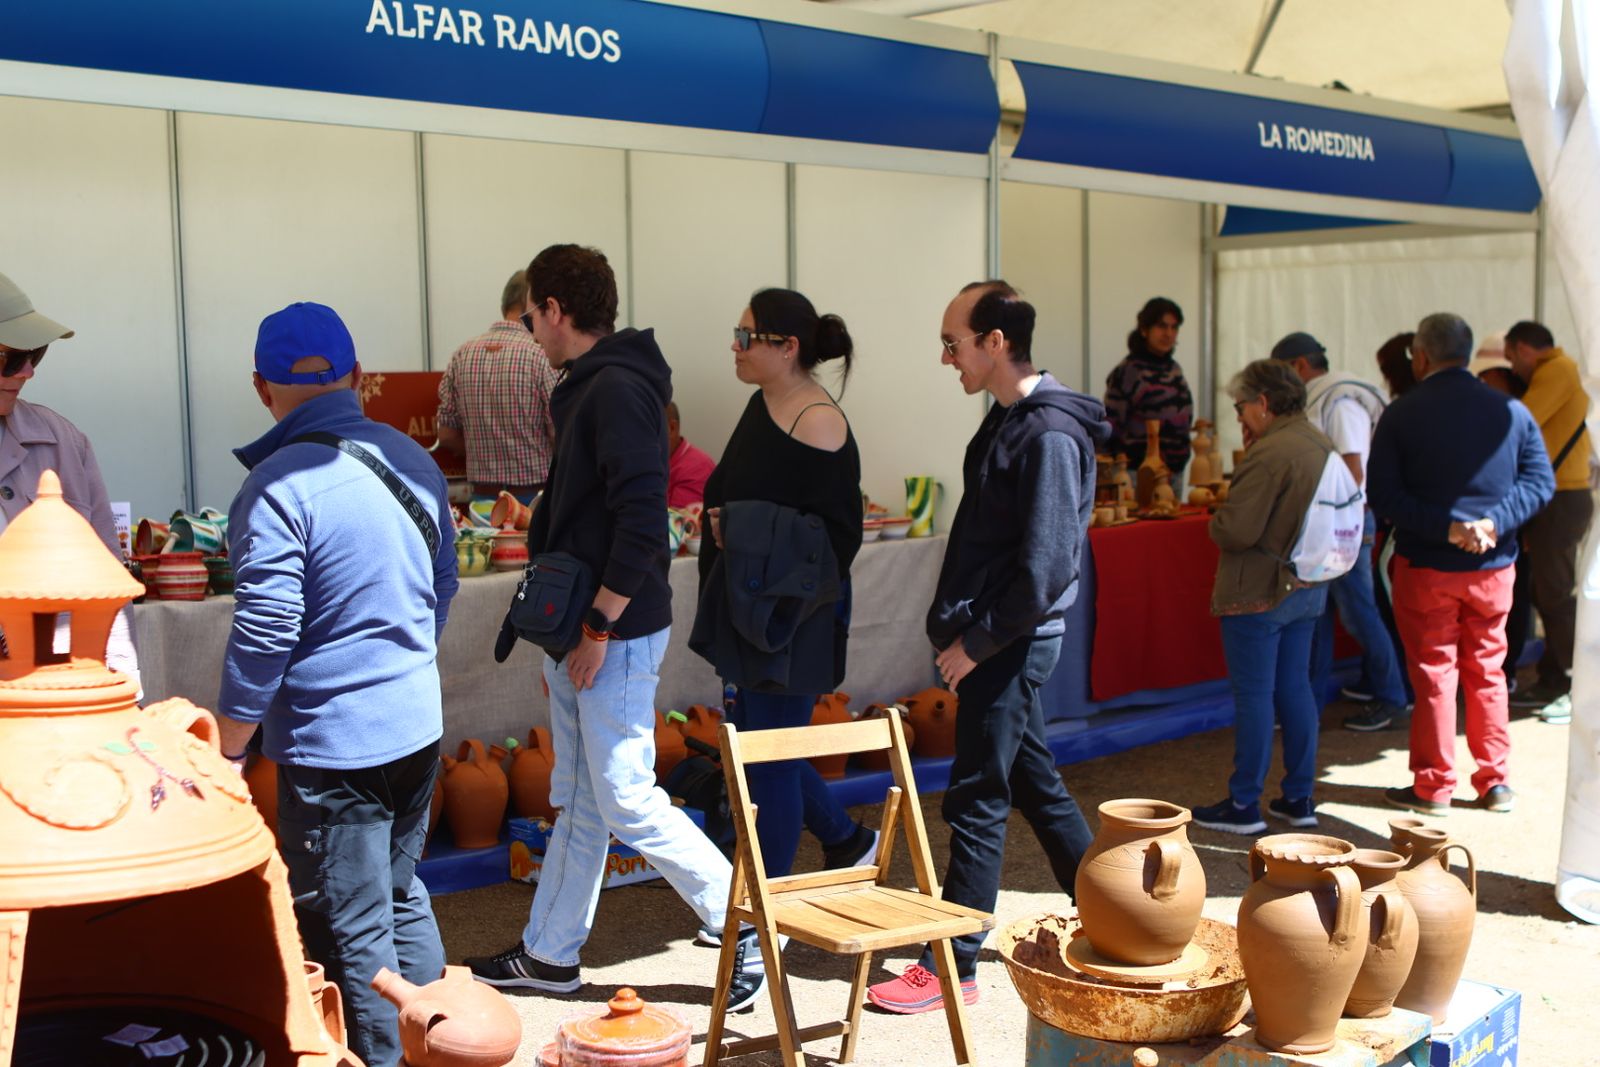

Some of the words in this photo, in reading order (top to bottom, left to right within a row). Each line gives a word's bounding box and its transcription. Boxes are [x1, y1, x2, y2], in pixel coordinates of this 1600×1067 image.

[365, 0, 485, 46] ALFAR
[493, 14, 621, 63] RAMOS
[1258, 121, 1282, 149] LA
[1284, 125, 1375, 161] ROMEDINA
